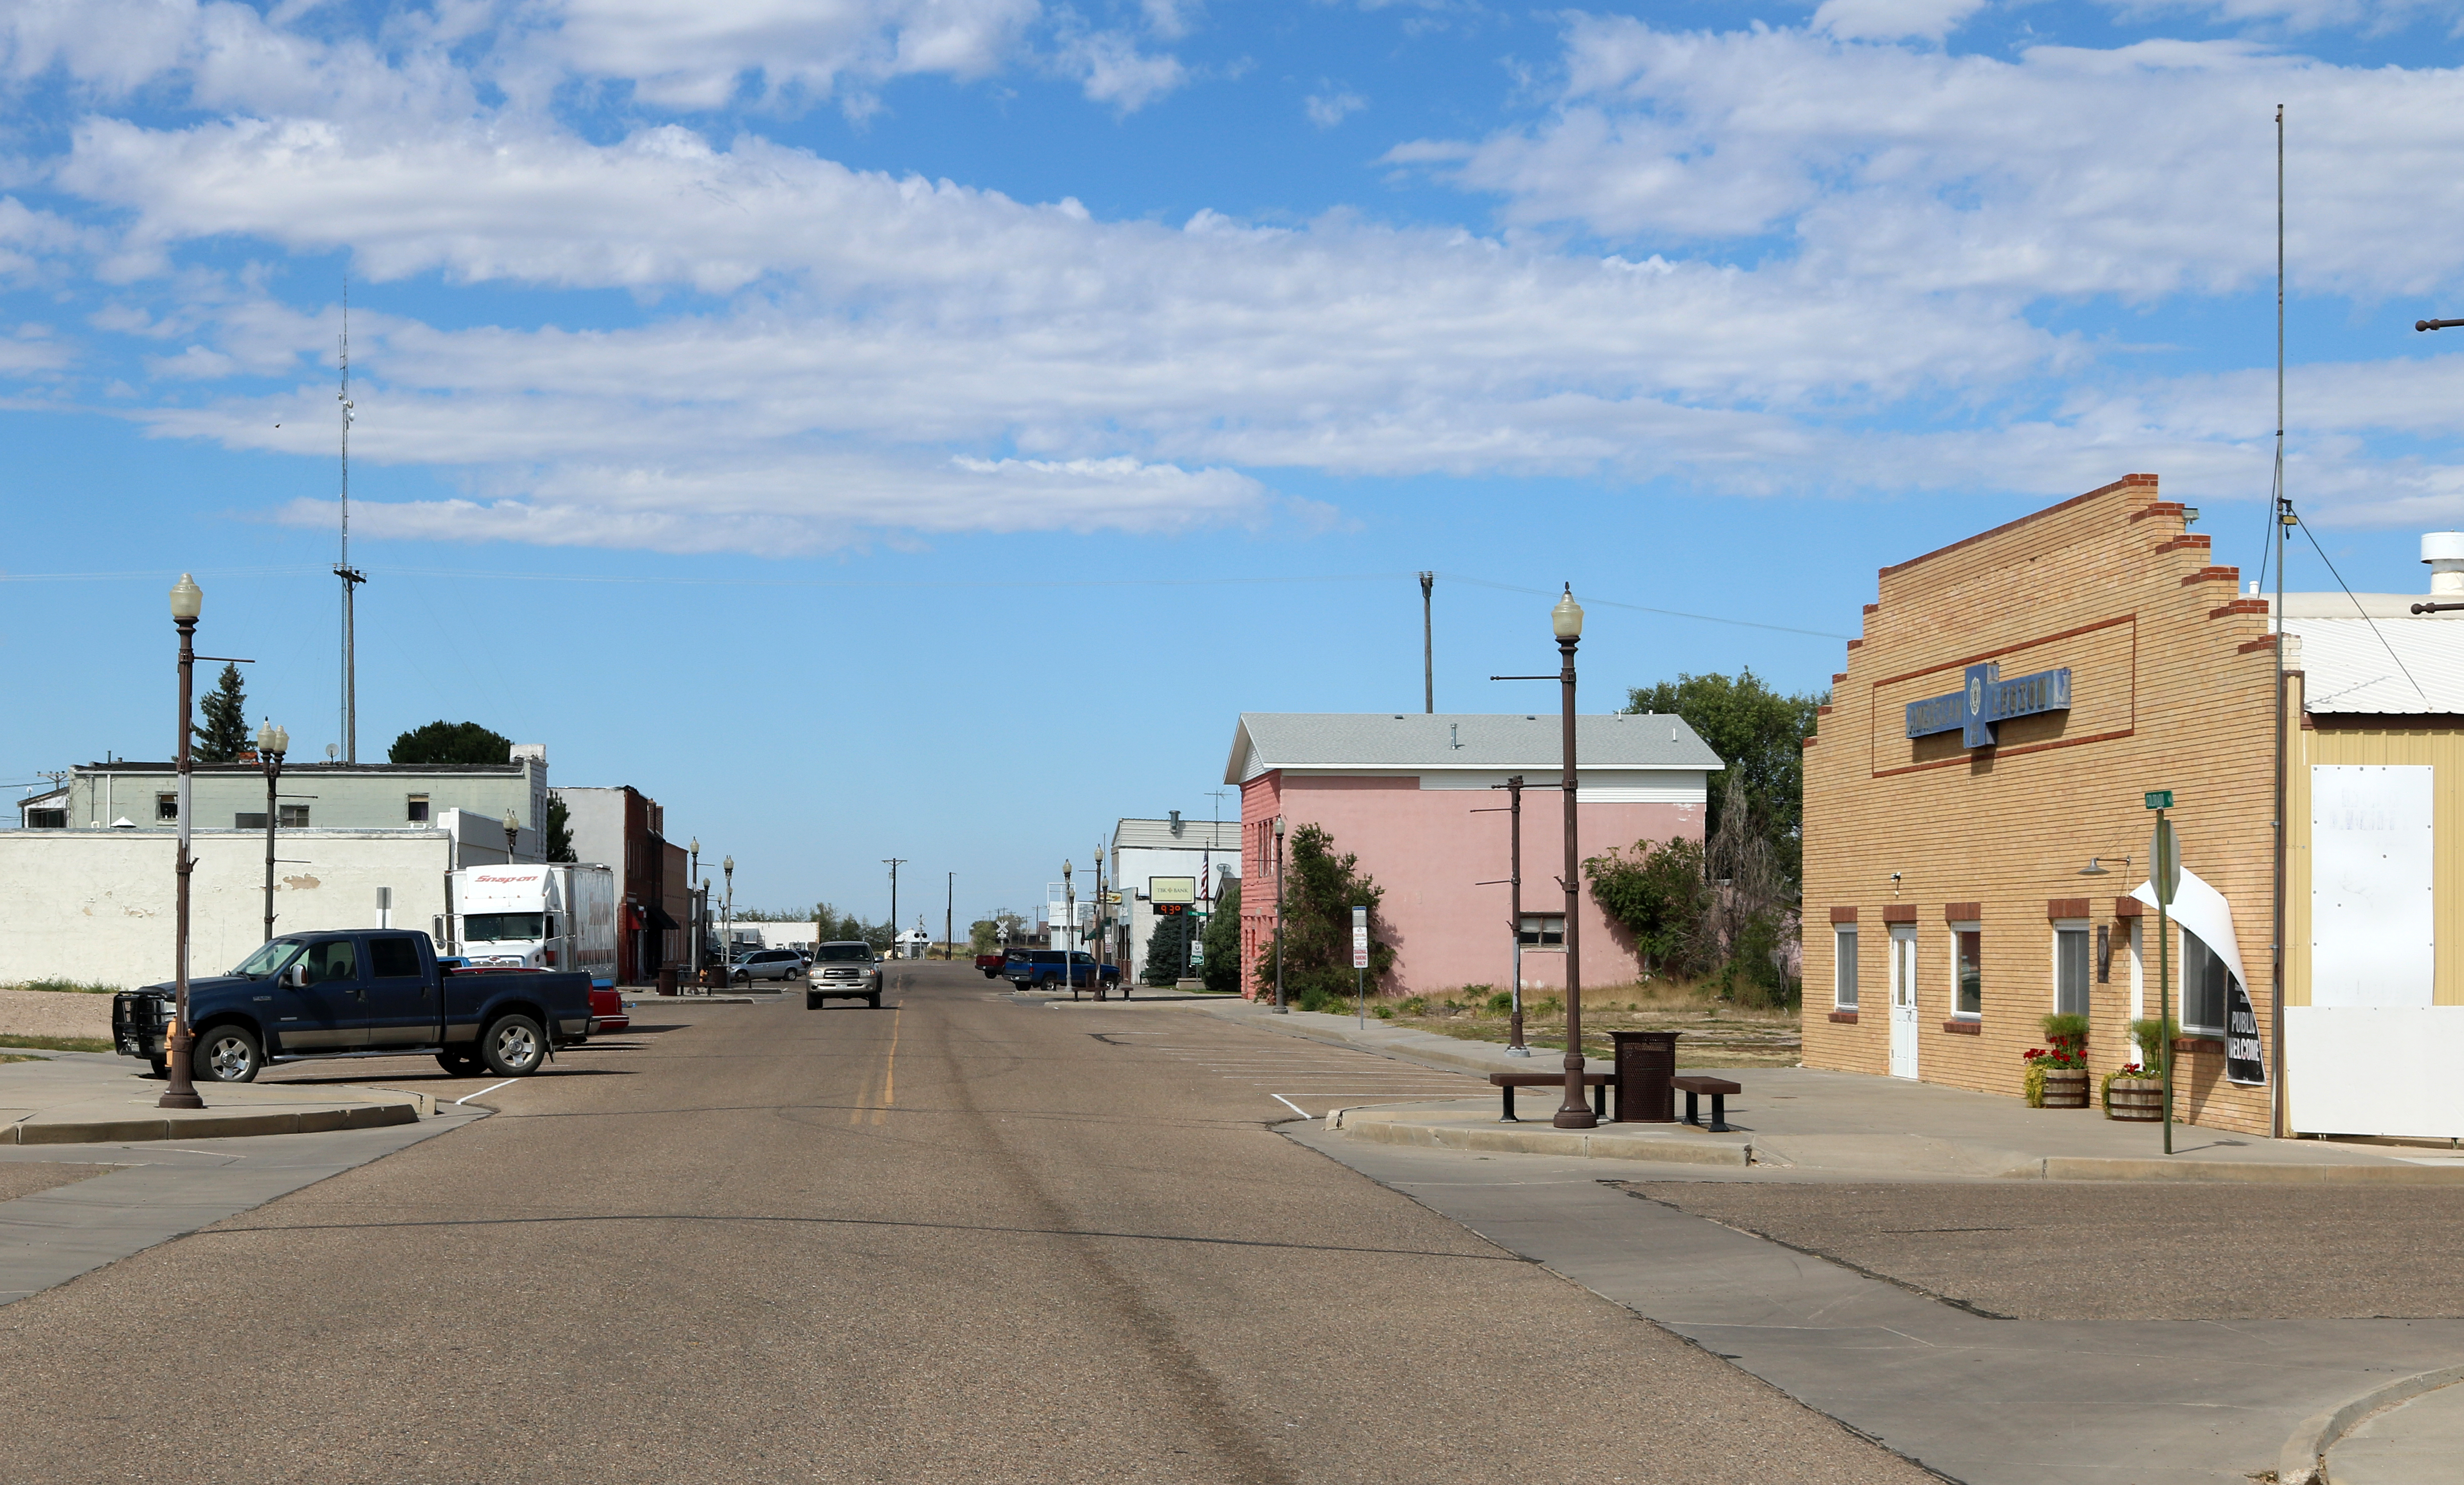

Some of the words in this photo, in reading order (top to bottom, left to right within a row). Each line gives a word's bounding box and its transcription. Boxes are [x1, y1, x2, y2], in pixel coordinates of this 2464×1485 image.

[1910, 698, 1962, 729] AMERICAN
[1992, 678, 2046, 715] LEGION
[2147, 794, 2164, 806] COLORADO
[2232, 1011, 2255, 1034] PUBLIC
[2227, 1037, 2259, 1062] WELCOME
